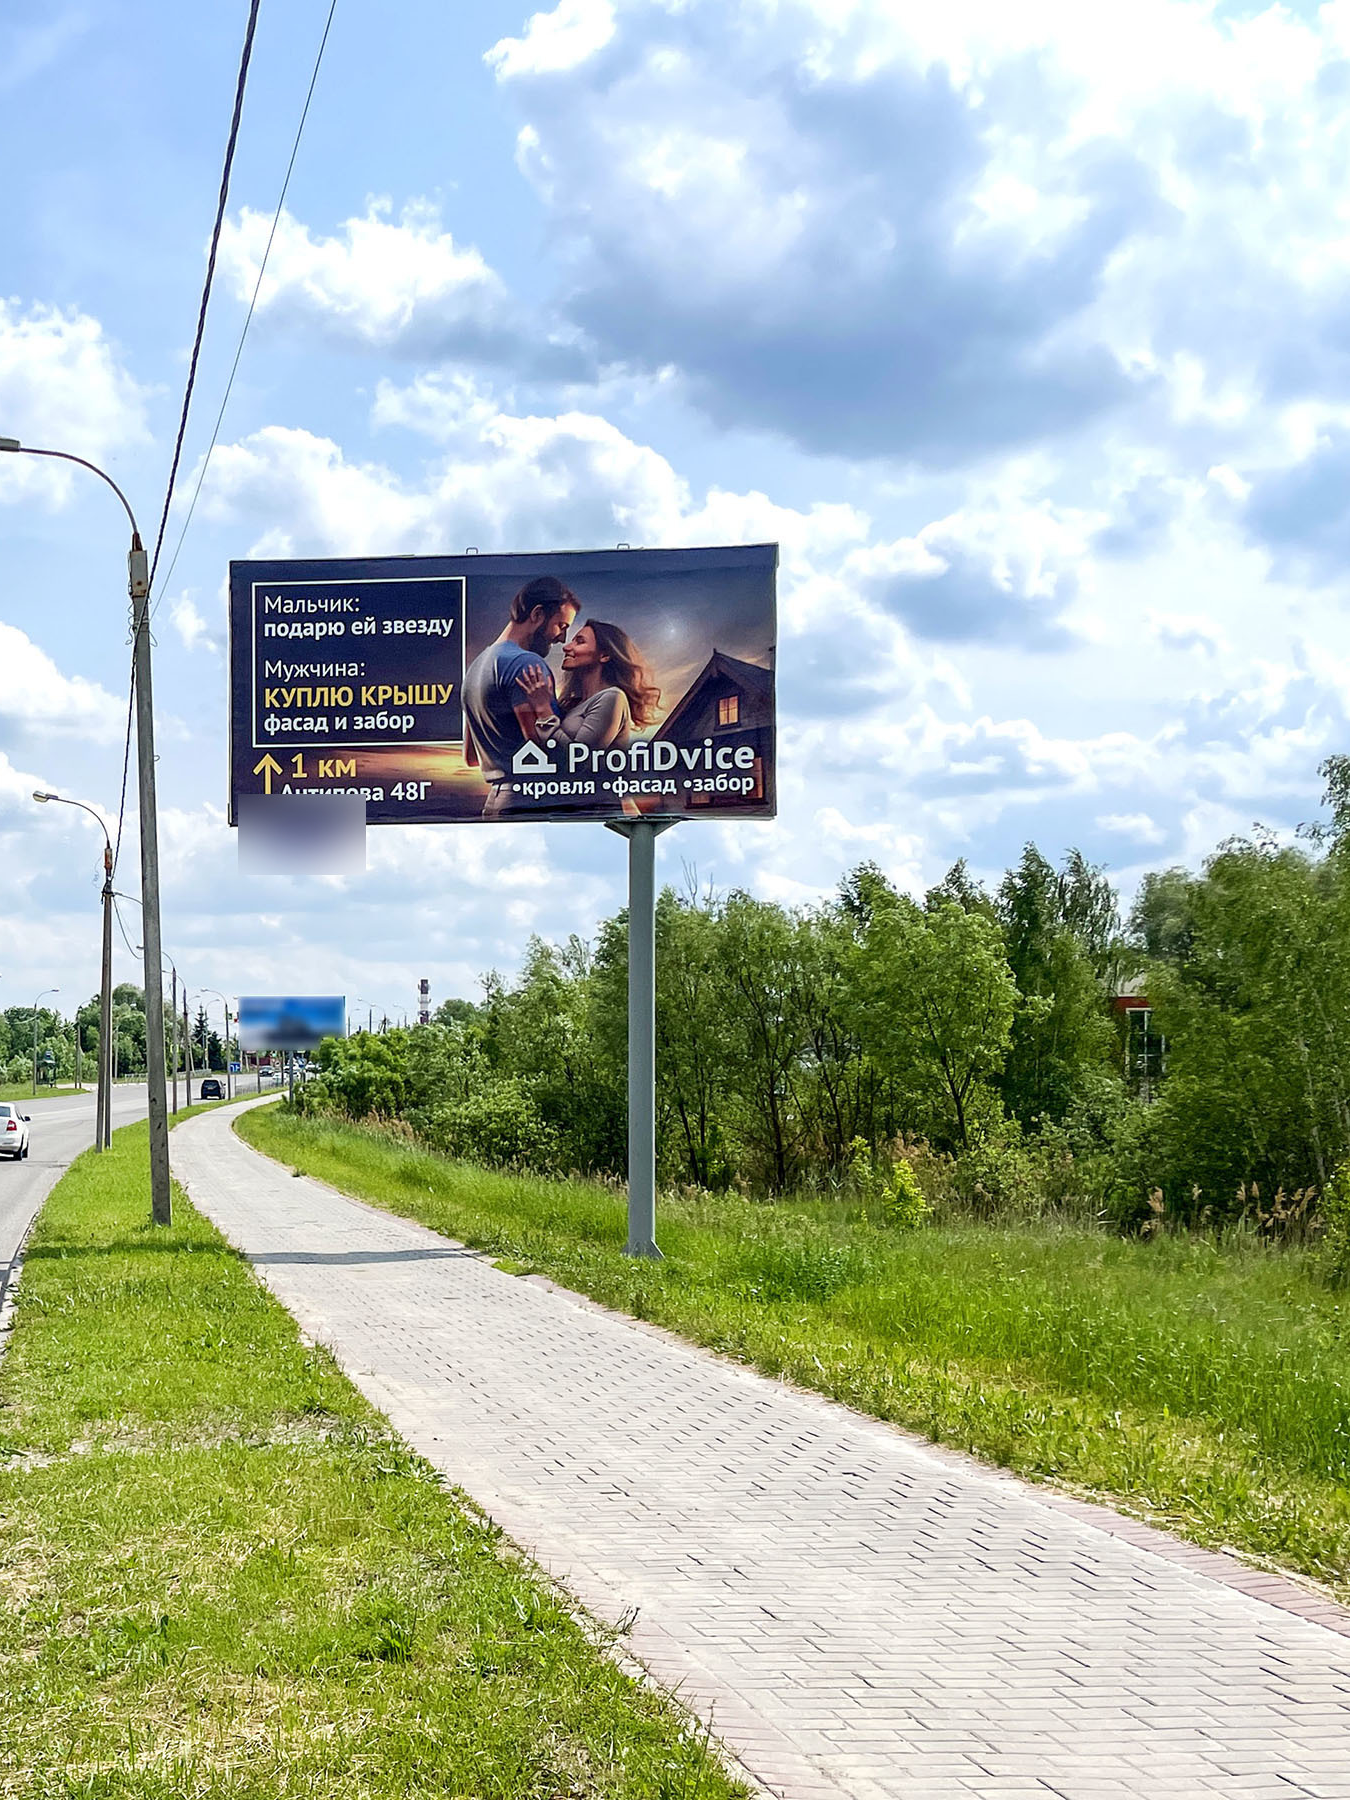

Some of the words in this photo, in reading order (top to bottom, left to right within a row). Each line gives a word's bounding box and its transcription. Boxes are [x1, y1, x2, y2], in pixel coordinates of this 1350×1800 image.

[264, 595, 360, 614] Мальчик:
[264, 621, 346, 640] подарю
[351, 617, 376, 636] ей
[382, 618, 454, 637] звезду
[264, 660, 366, 682] Мужчина:
[264, 686, 354, 708] КУПЛЮ
[361, 684, 454, 706] КРЫШУ
[264, 713, 329, 736] фасад
[335, 717, 347, 730] и
[353, 711, 415, 734] забор
[291, 752, 307, 778] 1
[568, 738, 755, 773] ProfiDvice
[390, 781, 432, 801] 48Г
